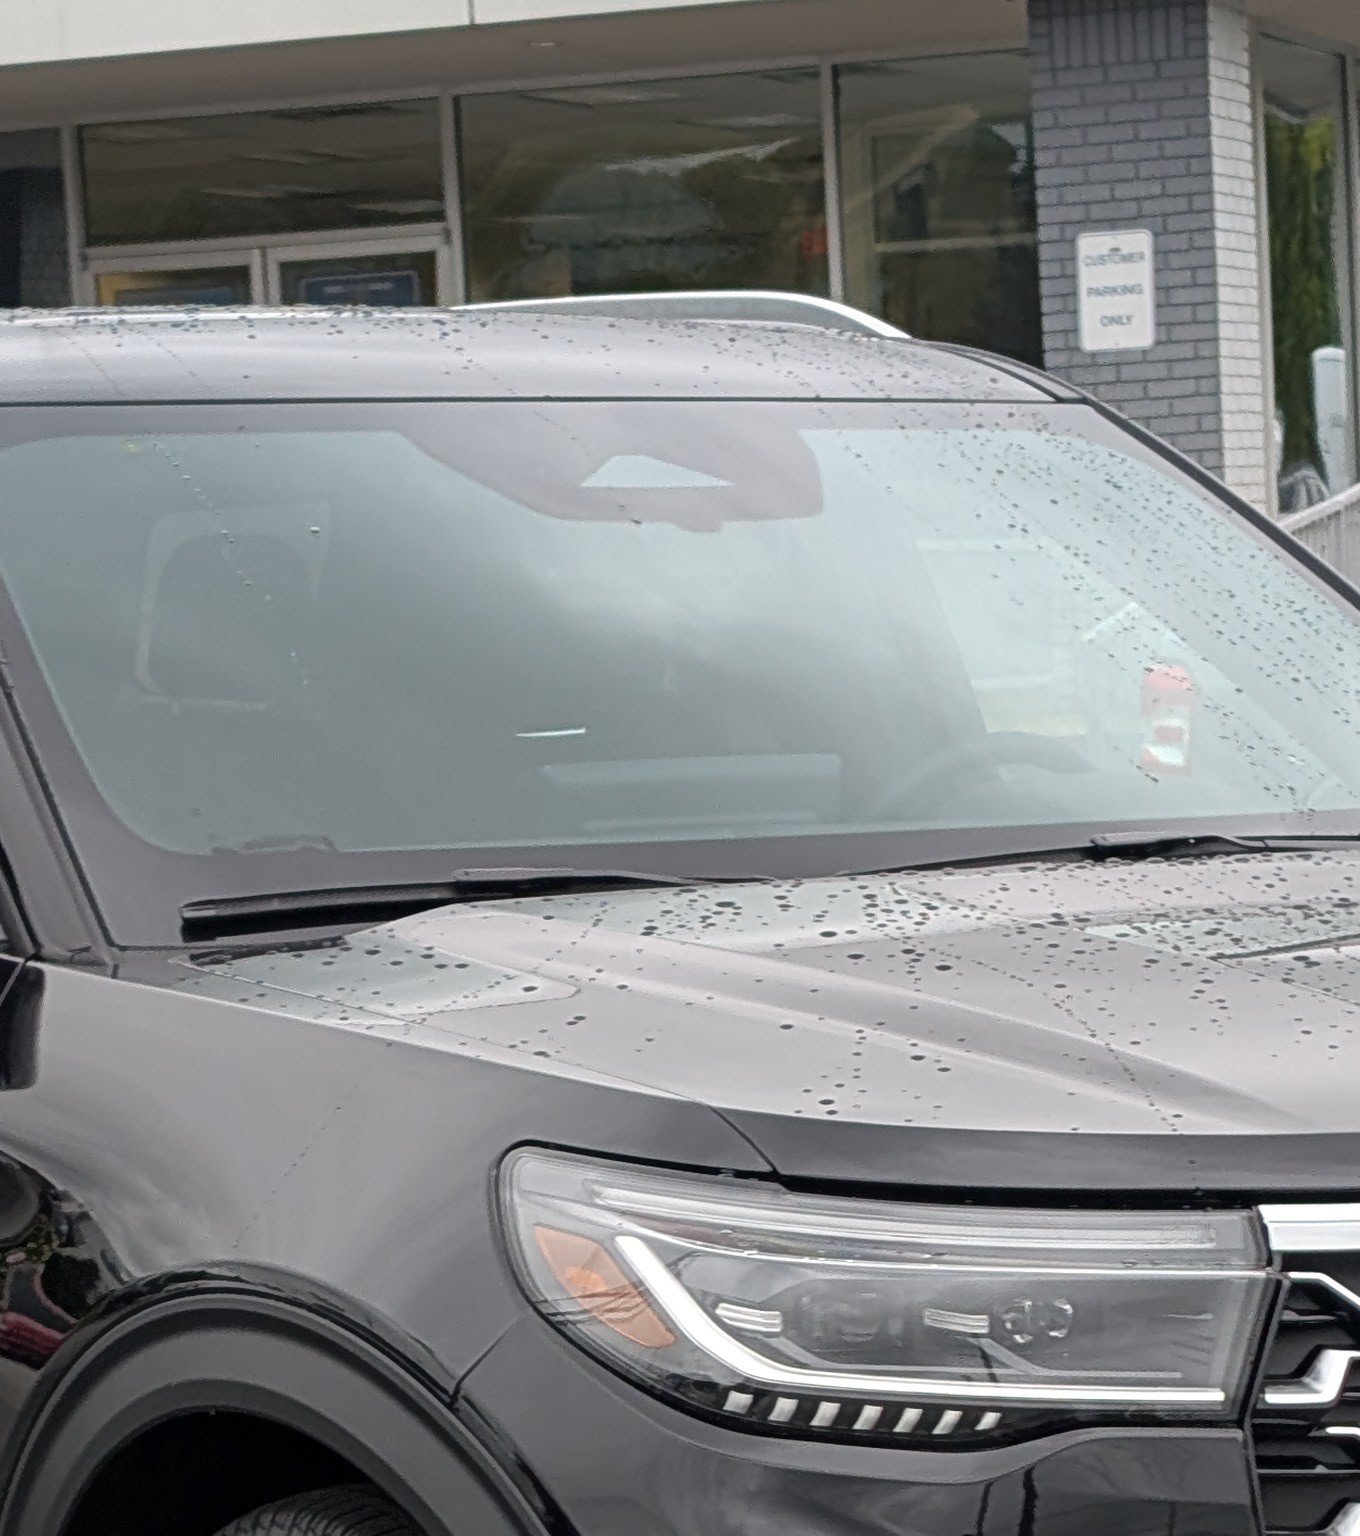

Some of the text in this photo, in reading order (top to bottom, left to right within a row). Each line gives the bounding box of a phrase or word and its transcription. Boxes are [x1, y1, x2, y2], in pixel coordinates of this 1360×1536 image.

[1083, 251, 1145, 267] CUSTOMER
[1086, 283, 1144, 298] PARKING
[1099, 314, 1136, 328] ONLY
